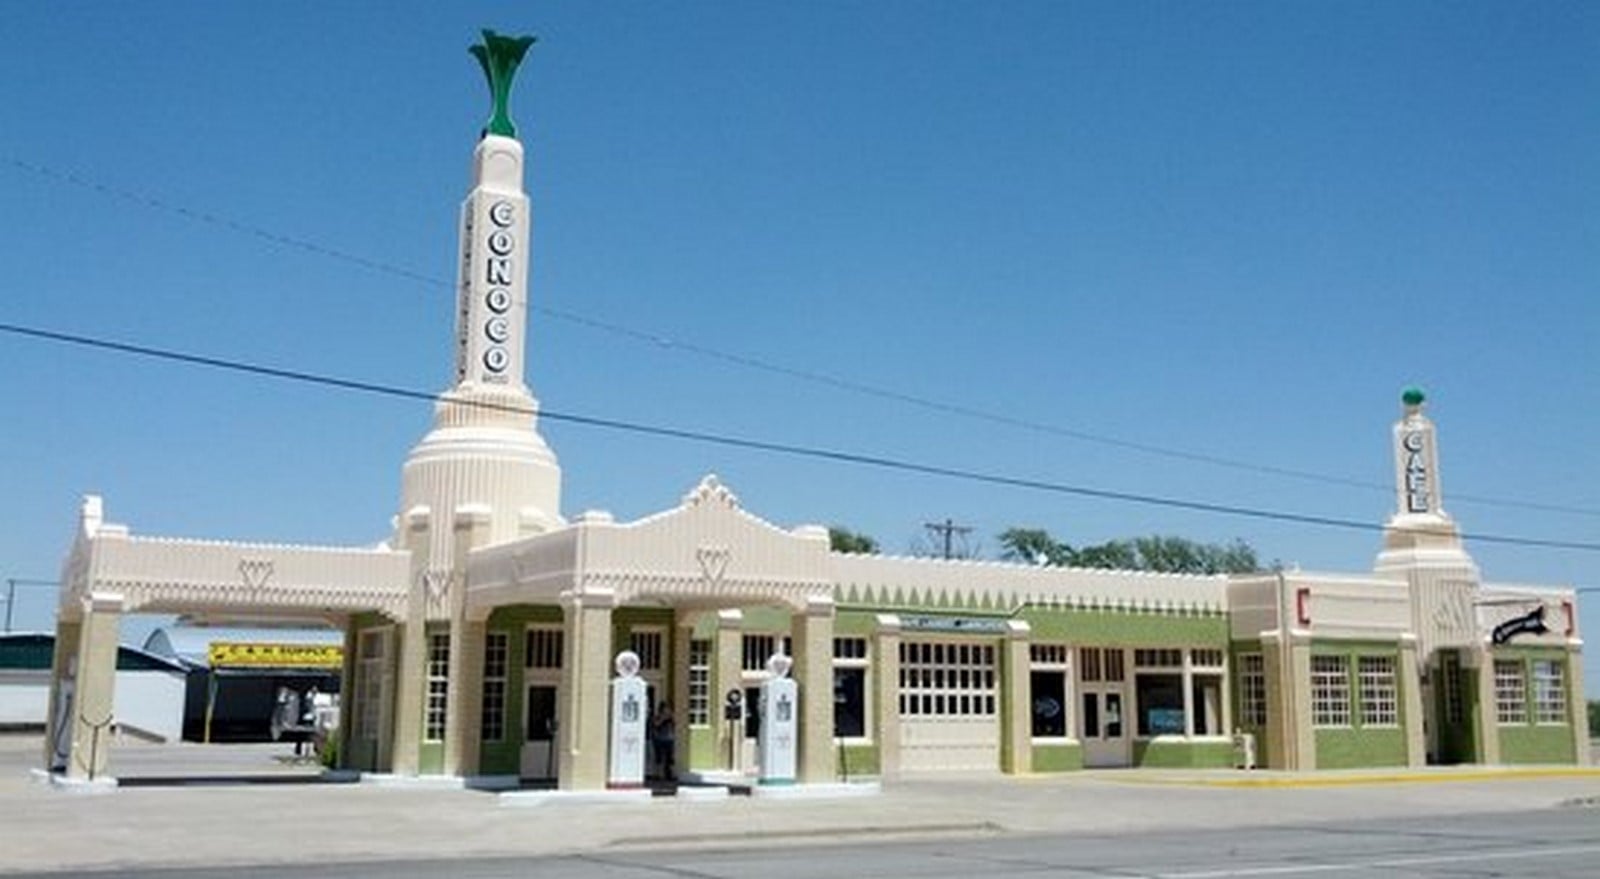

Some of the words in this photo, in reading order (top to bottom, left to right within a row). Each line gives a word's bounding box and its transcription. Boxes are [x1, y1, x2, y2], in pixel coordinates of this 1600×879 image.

[482, 201, 515, 373] CONOCO
[1403, 432, 1428, 513] CAFE
[280, 646, 328, 656] SUPPLY
